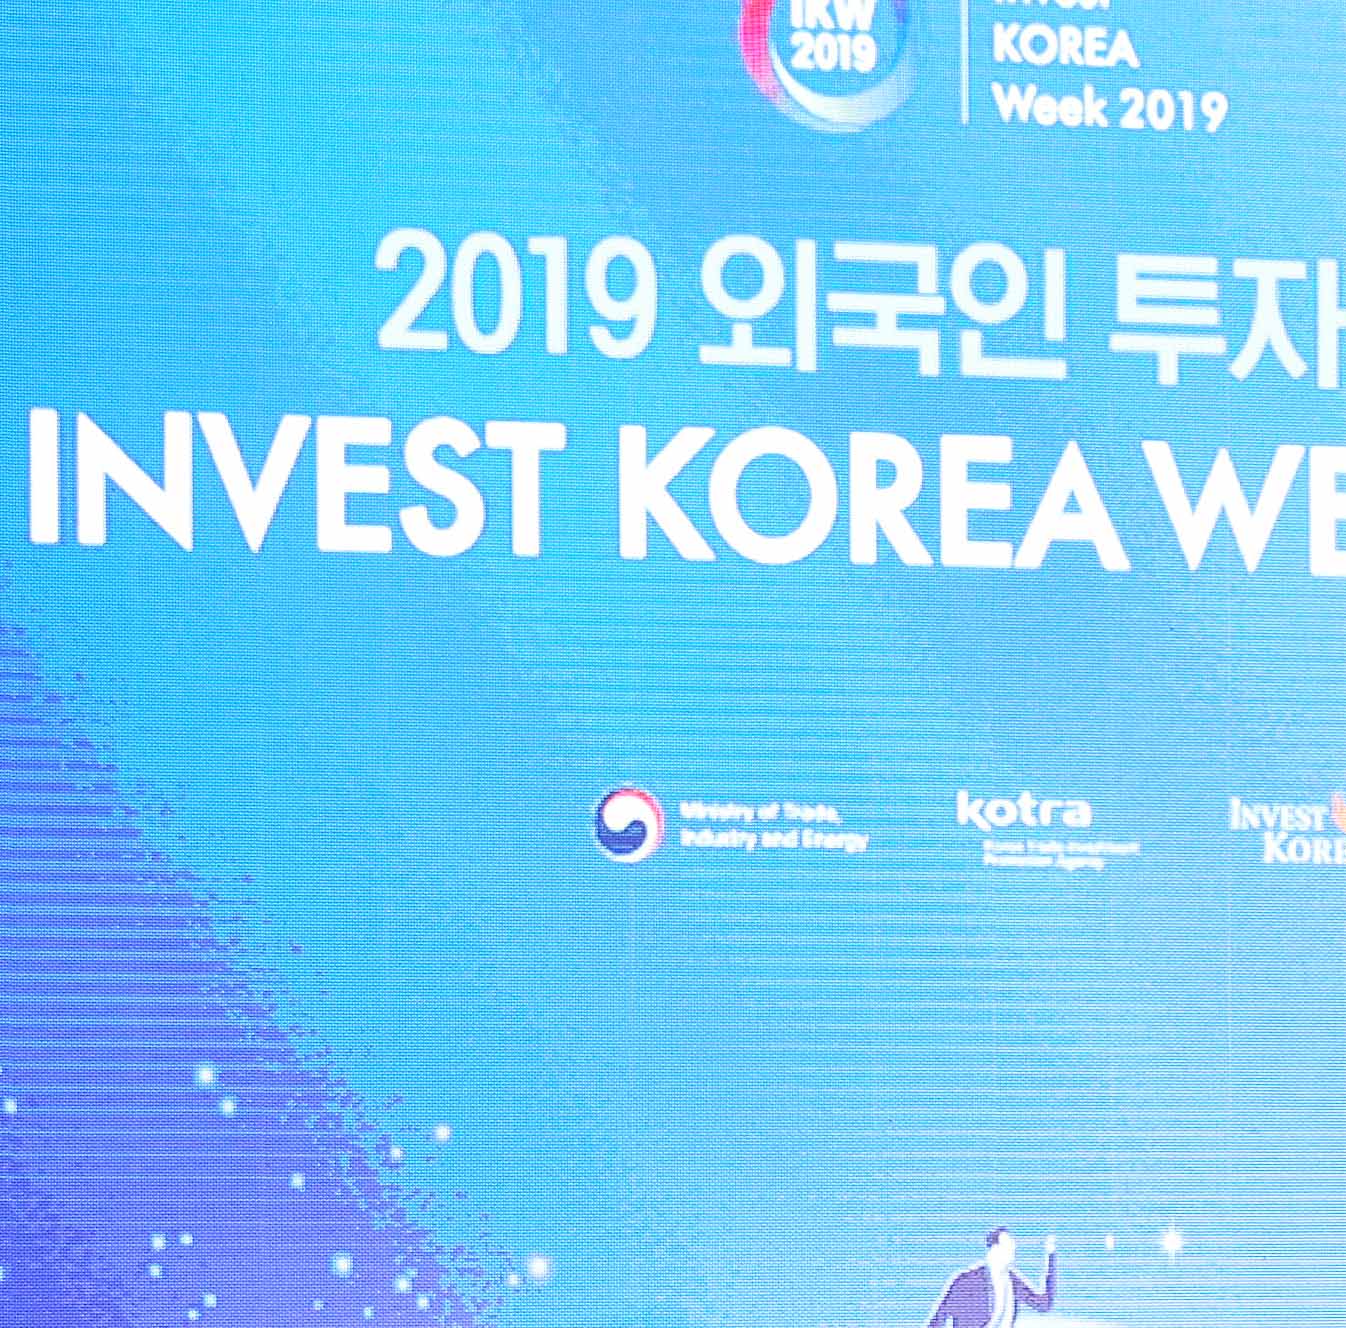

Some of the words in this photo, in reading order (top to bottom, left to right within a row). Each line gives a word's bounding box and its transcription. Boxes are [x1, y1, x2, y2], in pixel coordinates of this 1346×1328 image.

[790, 0, 875, 31] IKW
[790, 31, 878, 73] 2019
[992, 22, 1140, 69] KOREA
[991, 81, 1109, 128] Week
[1119, 88, 1229, 133] 2019
[374, 228, 658, 360] 2019
[698, 234, 1070, 381] 외국인
[27, 406, 567, 558] INVEST
[617, 424, 1132, 574] KOREA
[956, 790, 1093, 833] kotra
[1229, 796, 1329, 832] INVEST
